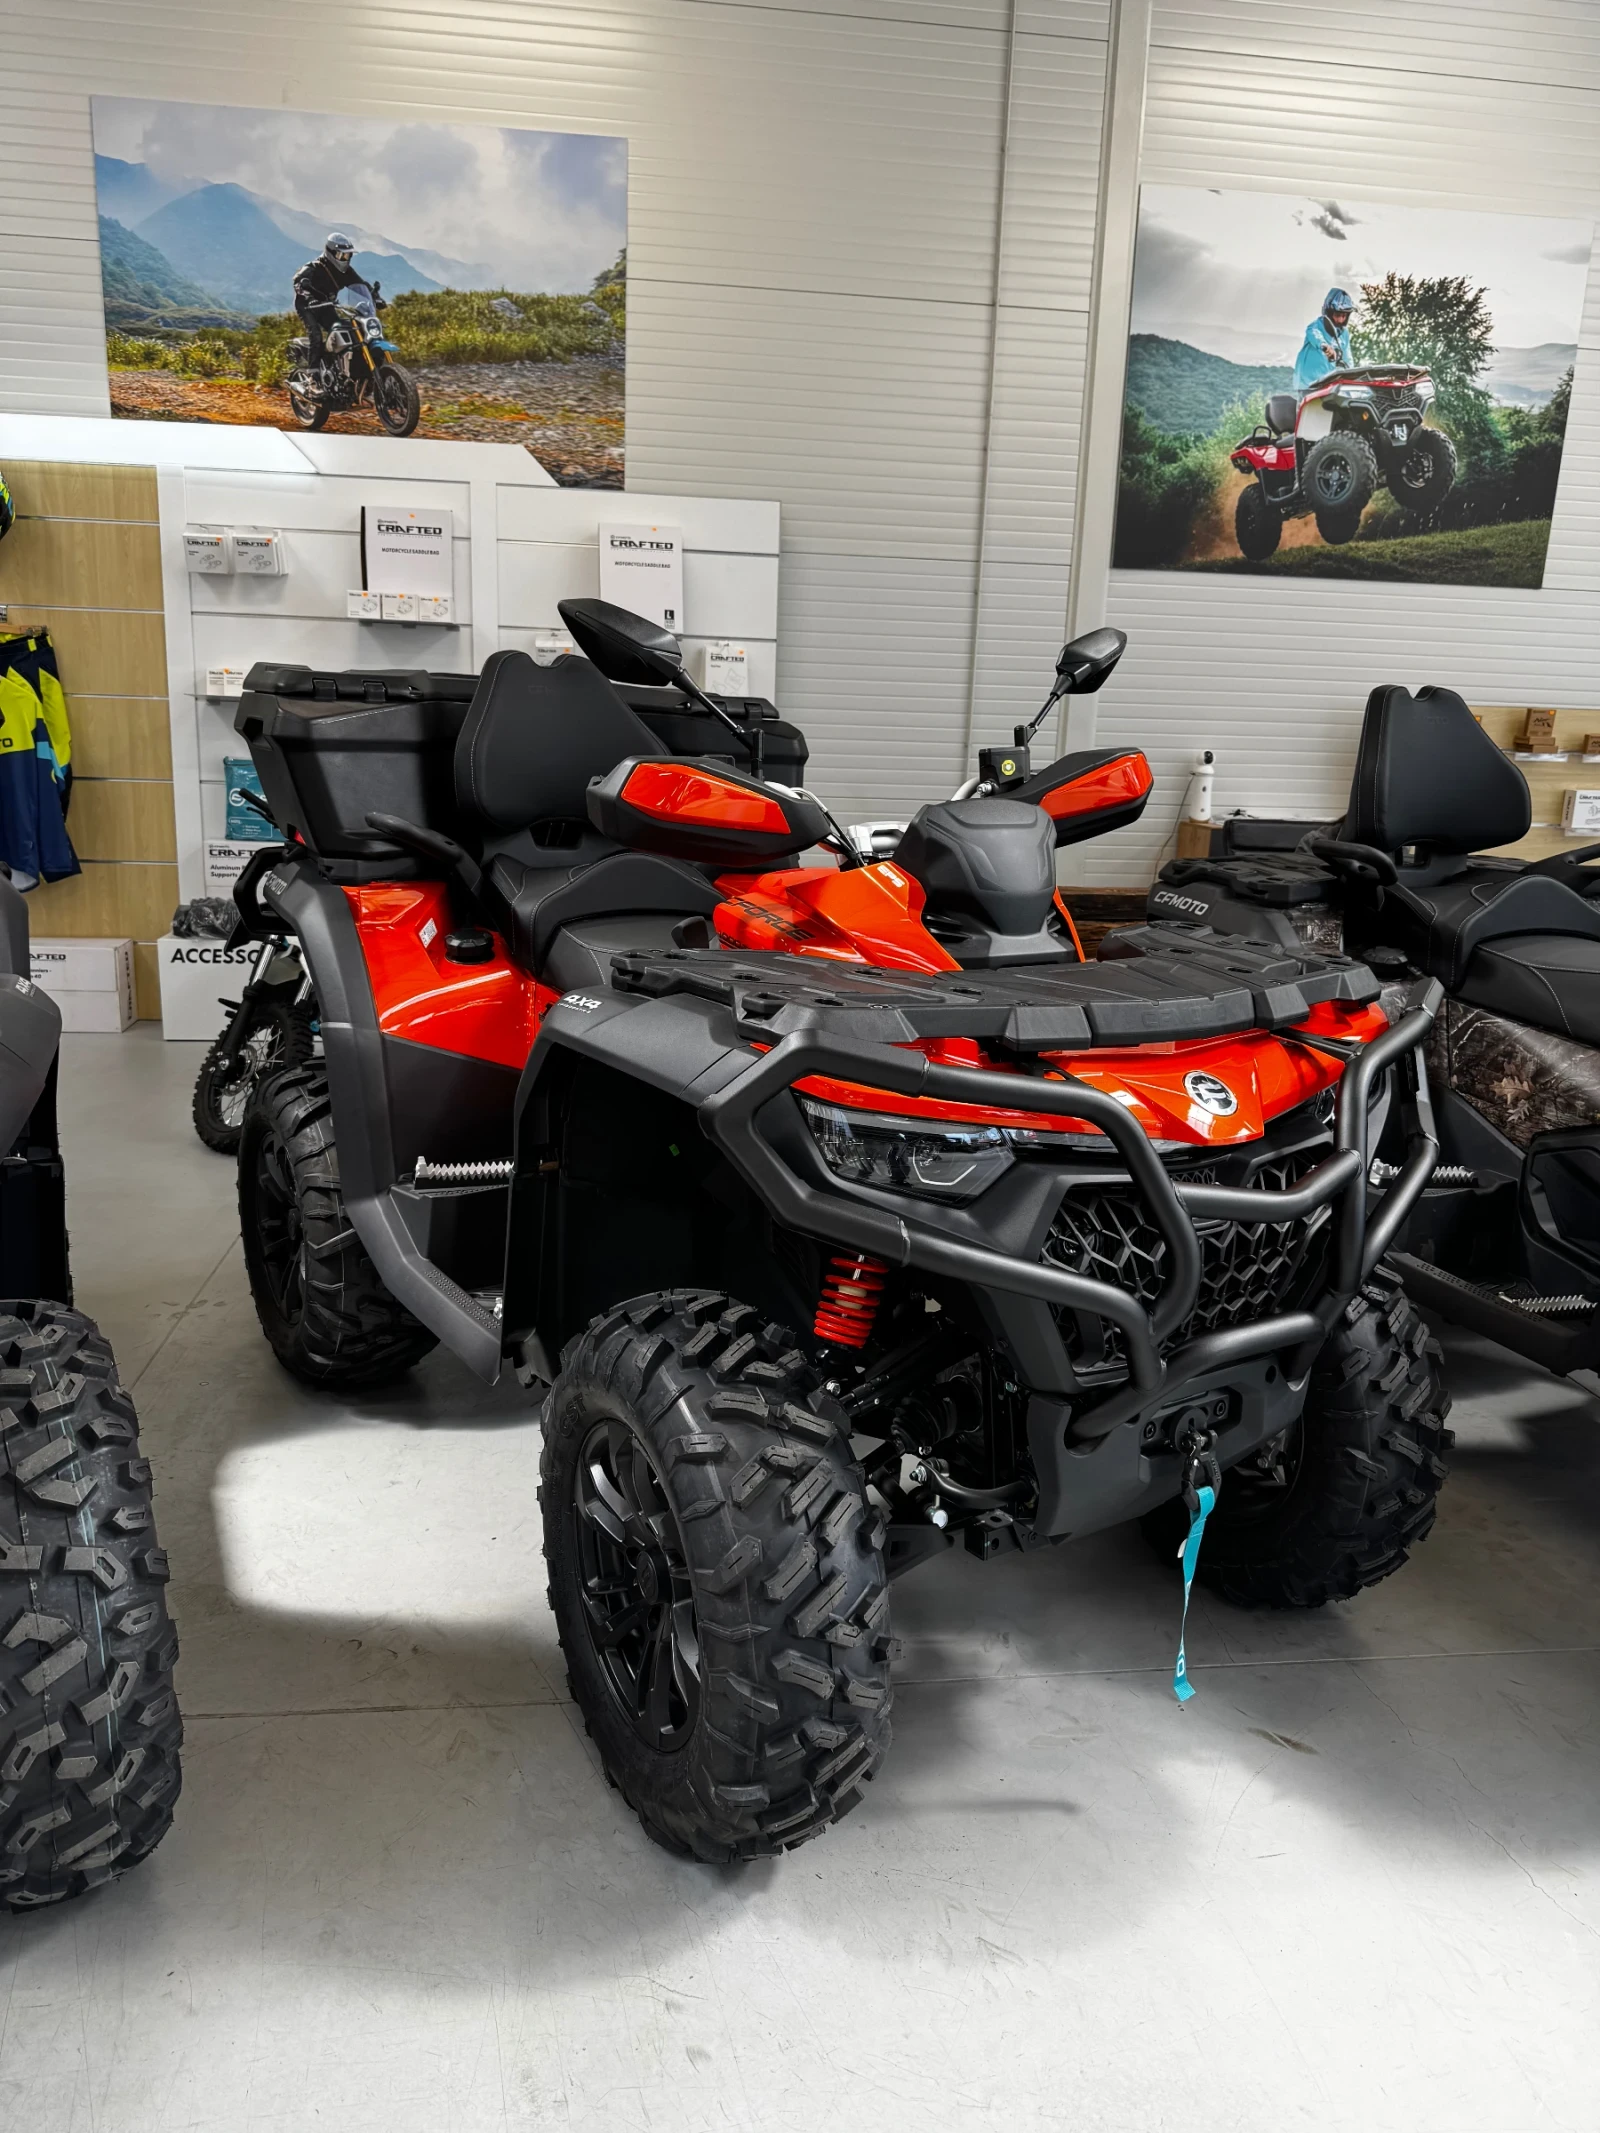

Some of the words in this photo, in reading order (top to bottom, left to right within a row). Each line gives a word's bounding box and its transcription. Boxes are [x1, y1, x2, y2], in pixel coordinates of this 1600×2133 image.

[377, 524, 443, 535] CRAFTED
[610, 540, 674, 550] CRAFTED
[209, 849, 258, 857] CRAFT
[877, 864, 905, 888] EPS
[1154, 891, 1209, 915] CFMOTO
[170, 947, 260, 964] ACCESSO
